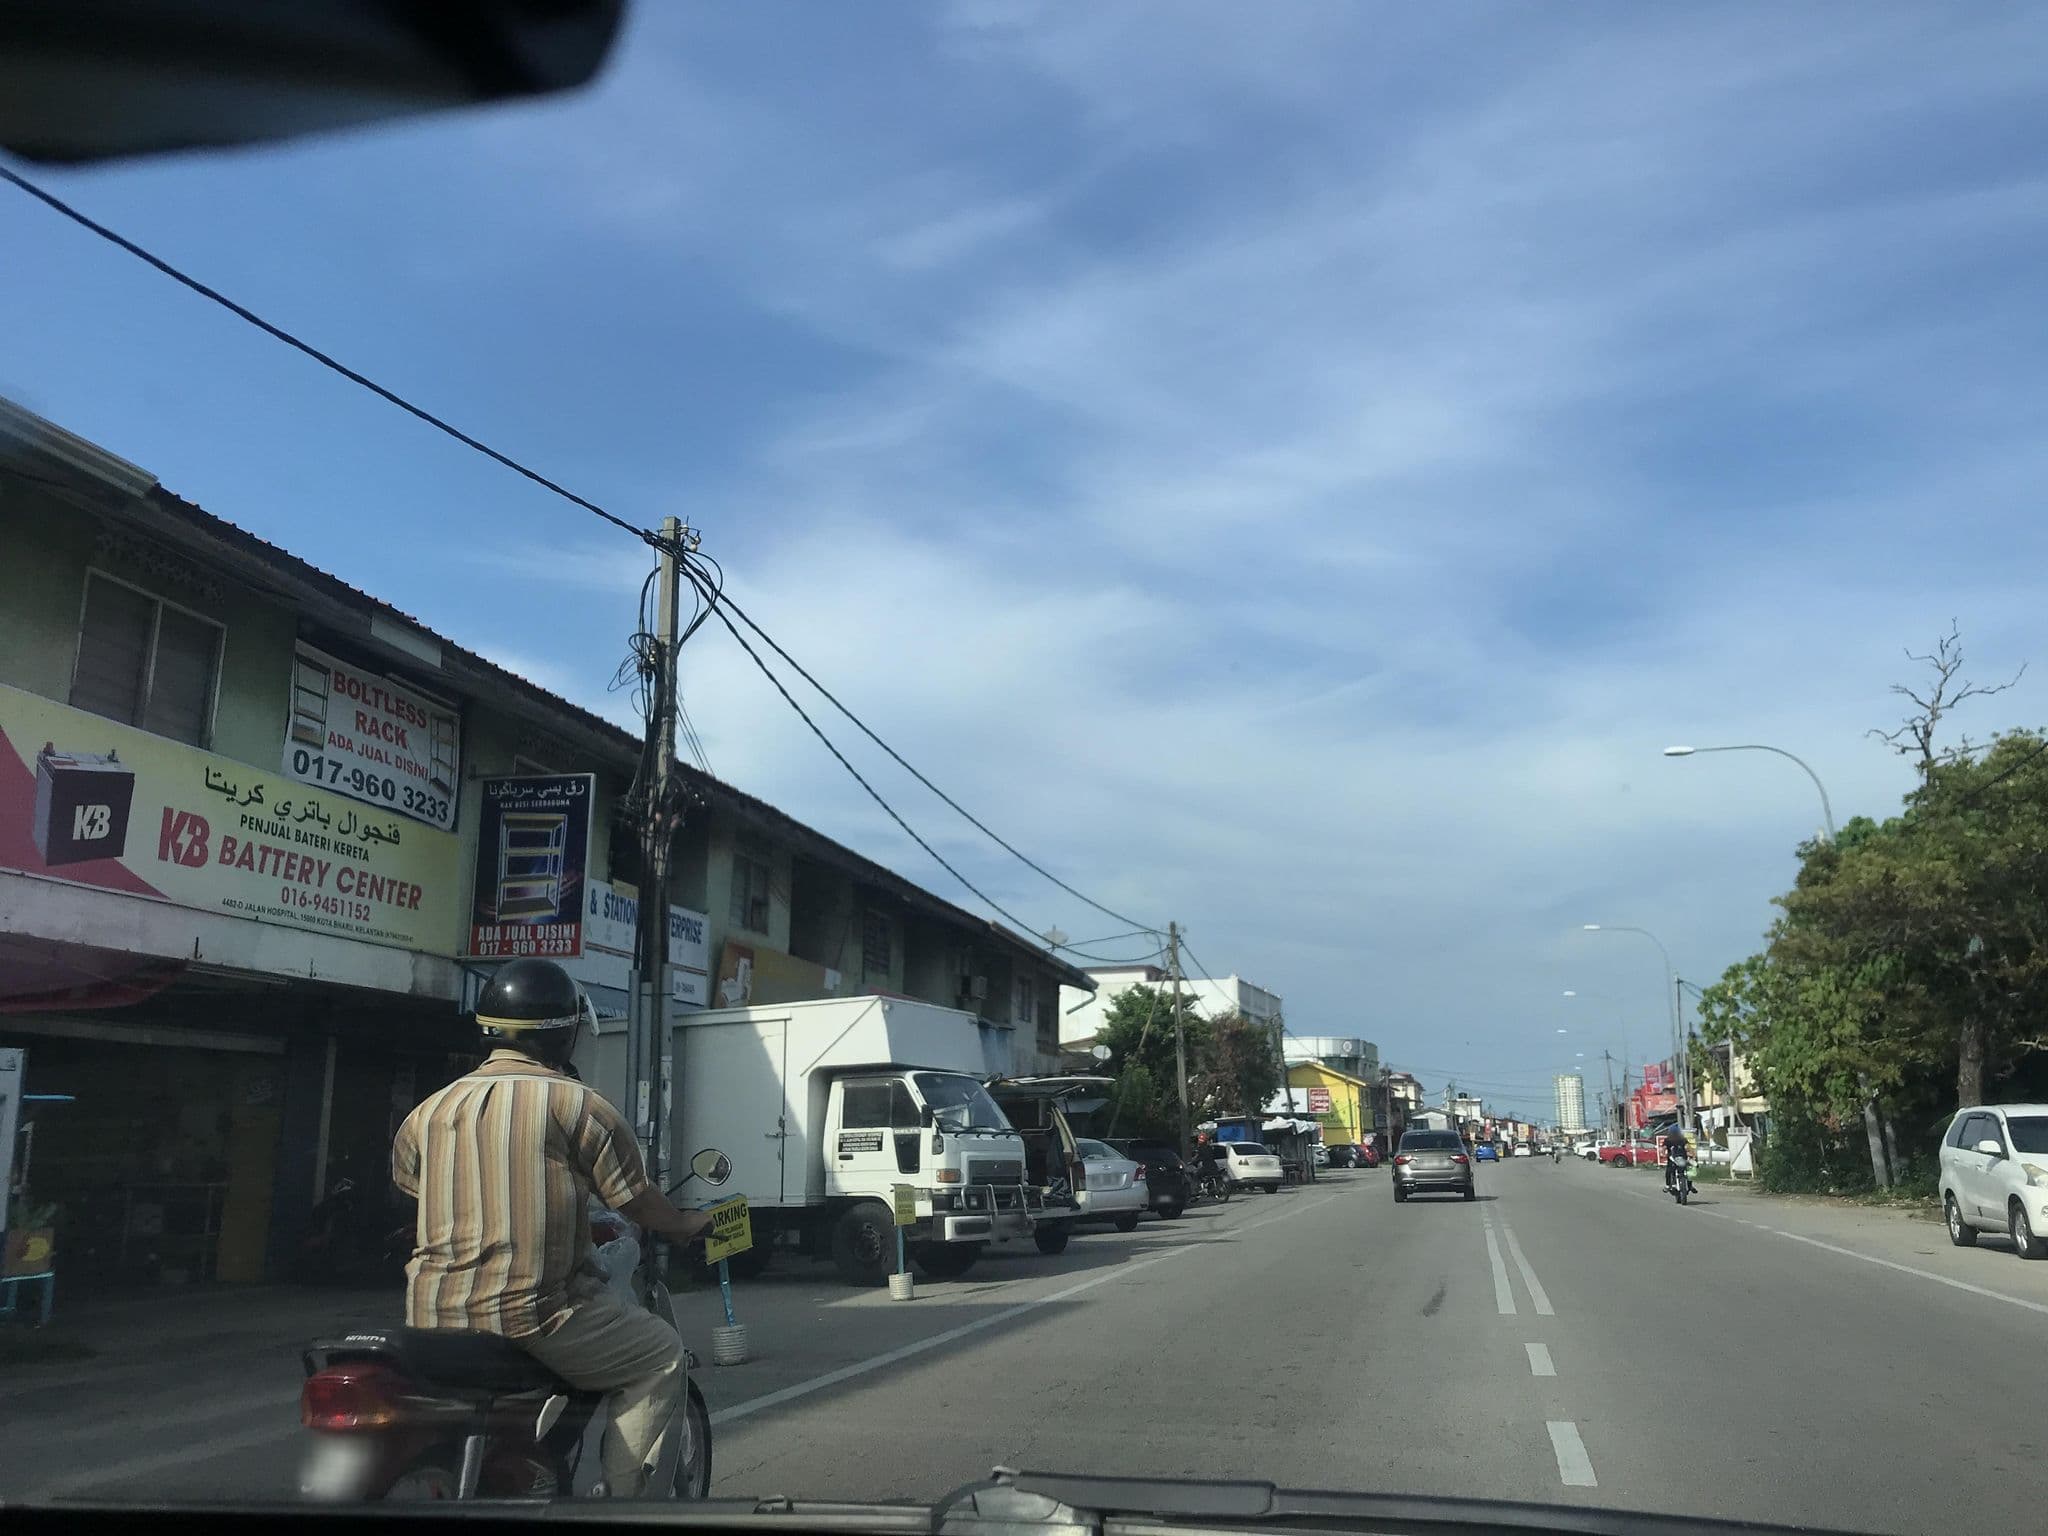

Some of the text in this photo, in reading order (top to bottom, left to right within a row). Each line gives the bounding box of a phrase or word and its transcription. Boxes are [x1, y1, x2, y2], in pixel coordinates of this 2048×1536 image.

[333, 671, 426, 729] BOLTLESS
[355, 710, 408, 750] RACK
[328, 731, 429, 780] ADA JUAL DISINI
[293, 750, 449, 823] 017-960 3233
[72, 804, 111, 840] KB
[241, 814, 370, 862] PENJUAL BATERI KERETA
[158, 806, 422, 911] KB BATTERY CENTER
[244, 902, 266, 914] JALAN
[281, 886, 371, 922] 016-9451152
[590, 887, 598, 915] &
[478, 923, 576, 942] ADA JUAL DISINI
[480, 941, 500, 955] 017
[512, 940, 536, 954] 960
[540, 939, 572, 954] 3233
